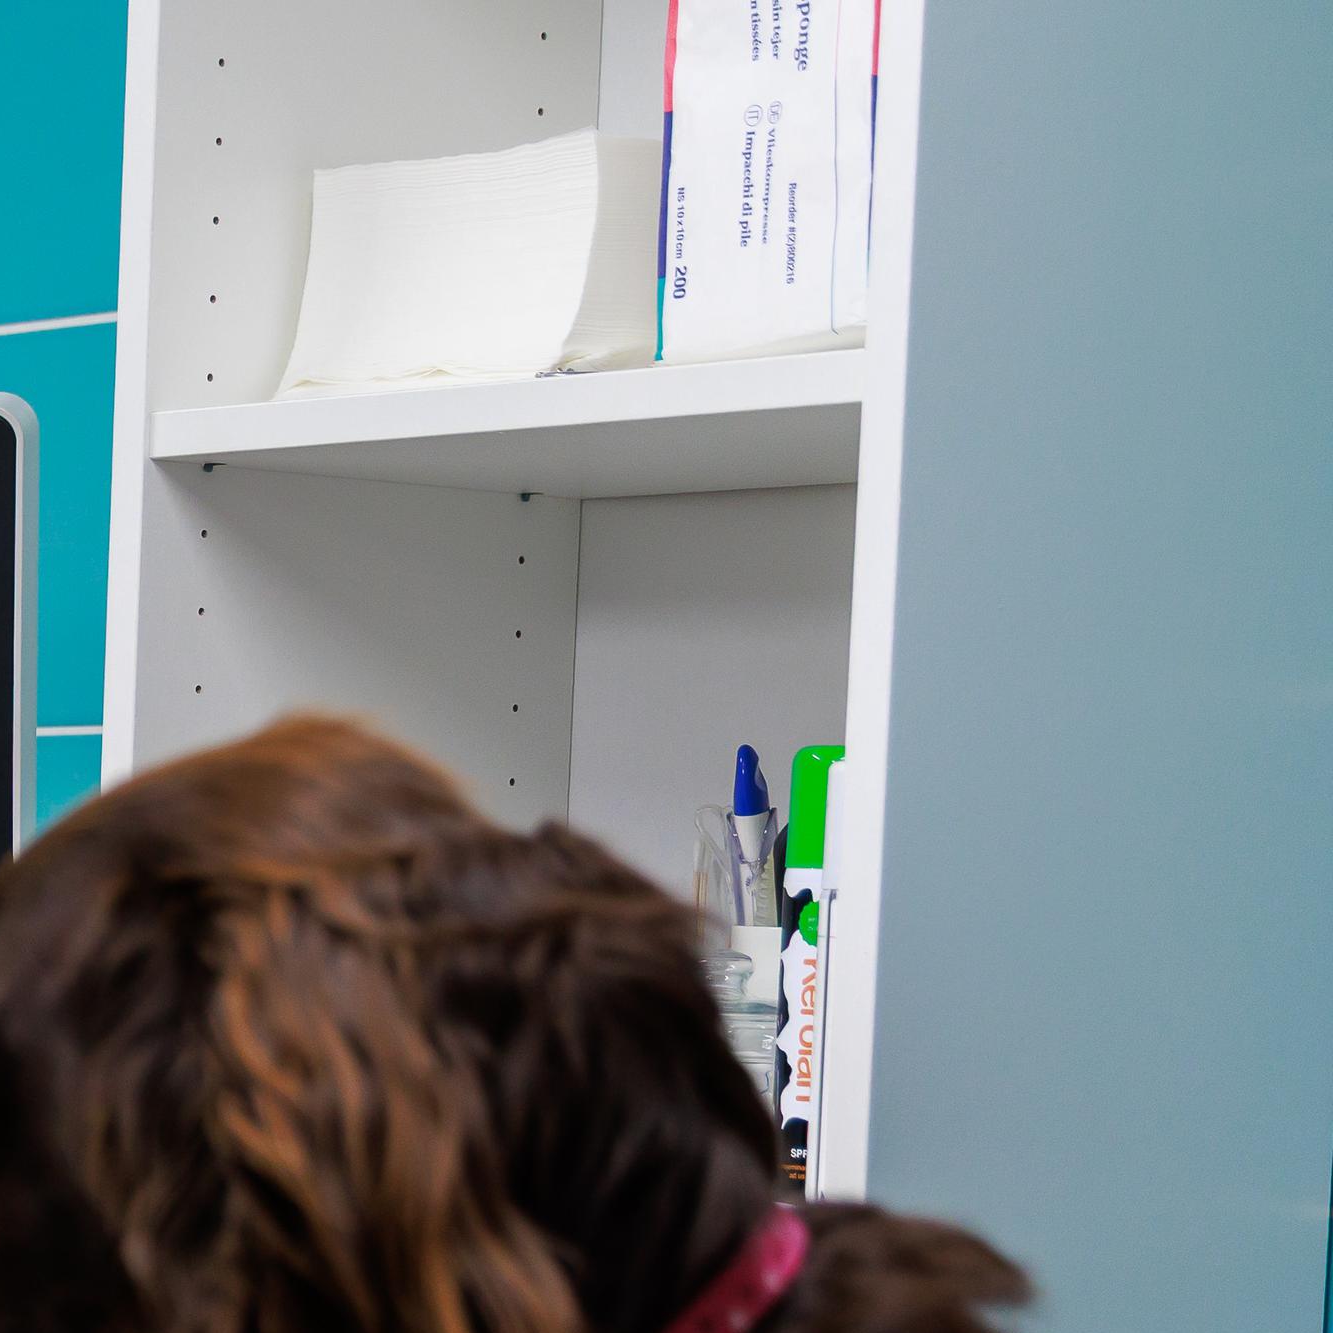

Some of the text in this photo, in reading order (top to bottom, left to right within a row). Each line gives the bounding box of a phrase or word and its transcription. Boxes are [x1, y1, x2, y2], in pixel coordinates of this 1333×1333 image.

[770, 26, 782, 60] tejer
[794, 0, 811, 72] ponge
[738, 130, 756, 248] Impacchi di pile
[761, 127, 776, 245] Vlieskompresse
[787, 182, 798, 223] Reorder
[672, 265, 688, 300] 200
